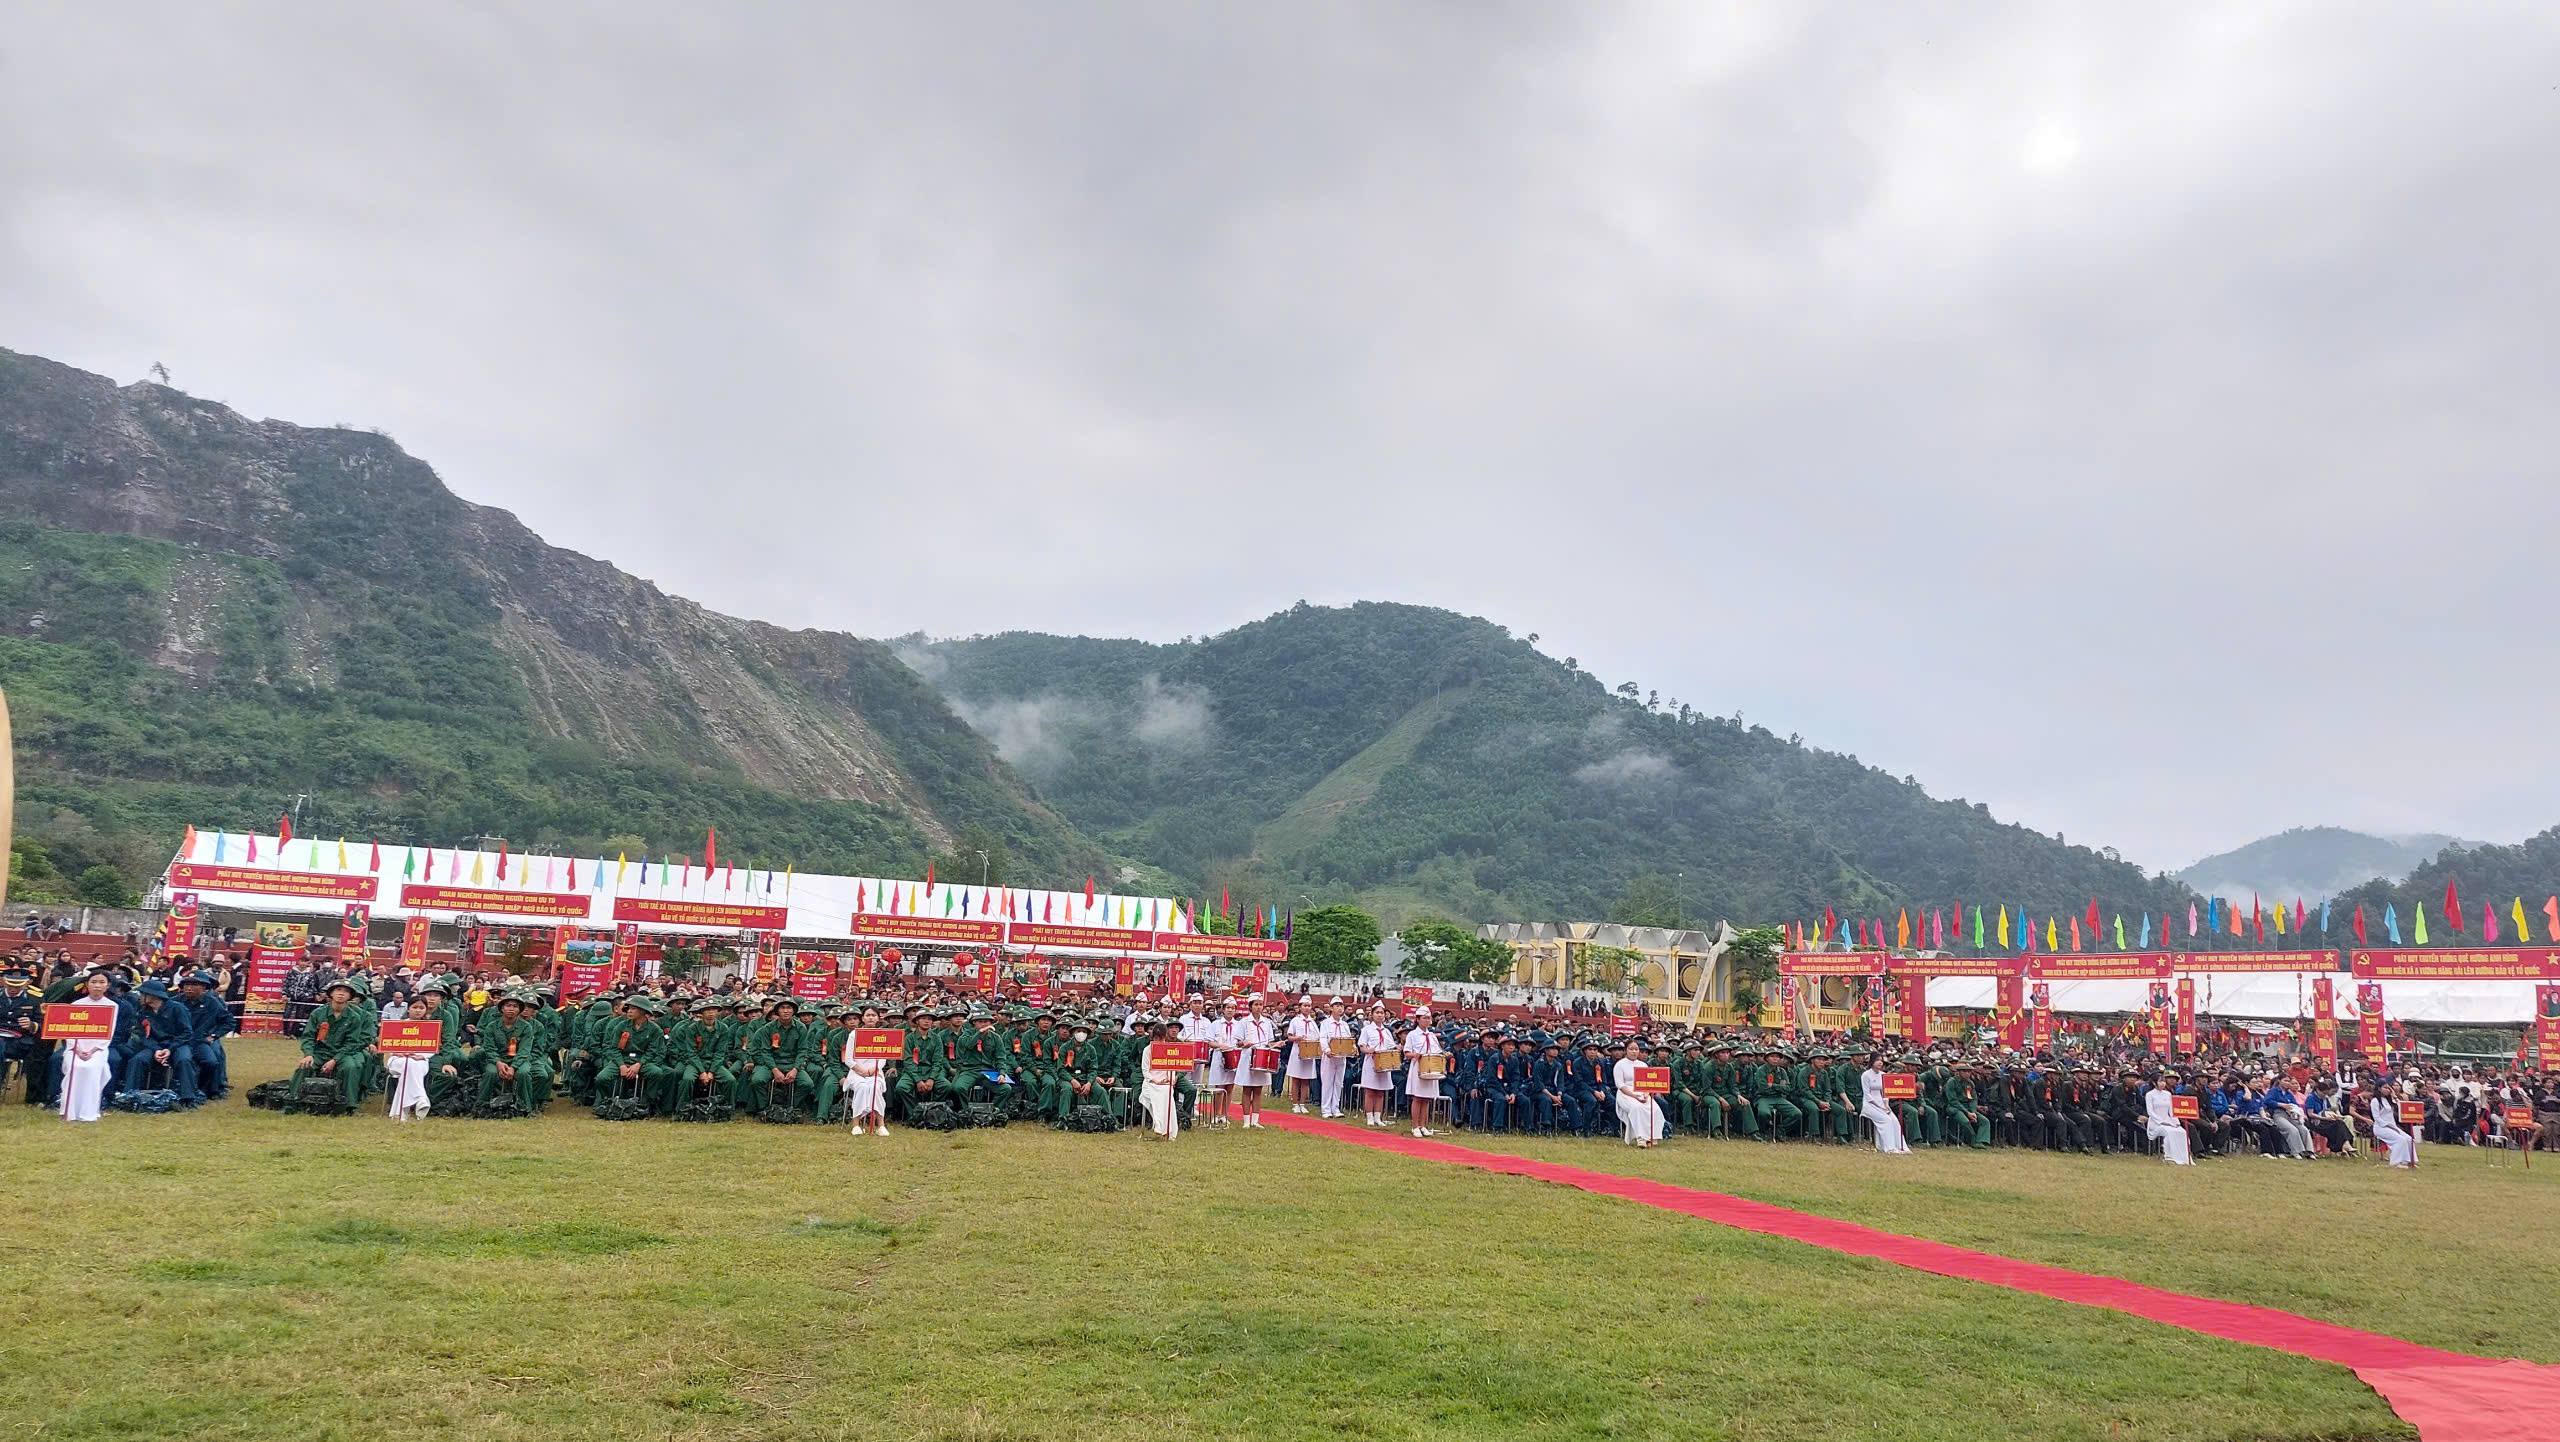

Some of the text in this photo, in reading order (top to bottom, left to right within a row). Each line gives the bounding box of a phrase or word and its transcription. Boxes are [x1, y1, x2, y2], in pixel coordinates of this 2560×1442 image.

[70, 1010, 88, 1020] KHỐI
[402, 1026, 419, 1035] KHỐI
[873, 1034, 886, 1042] KHỐI
